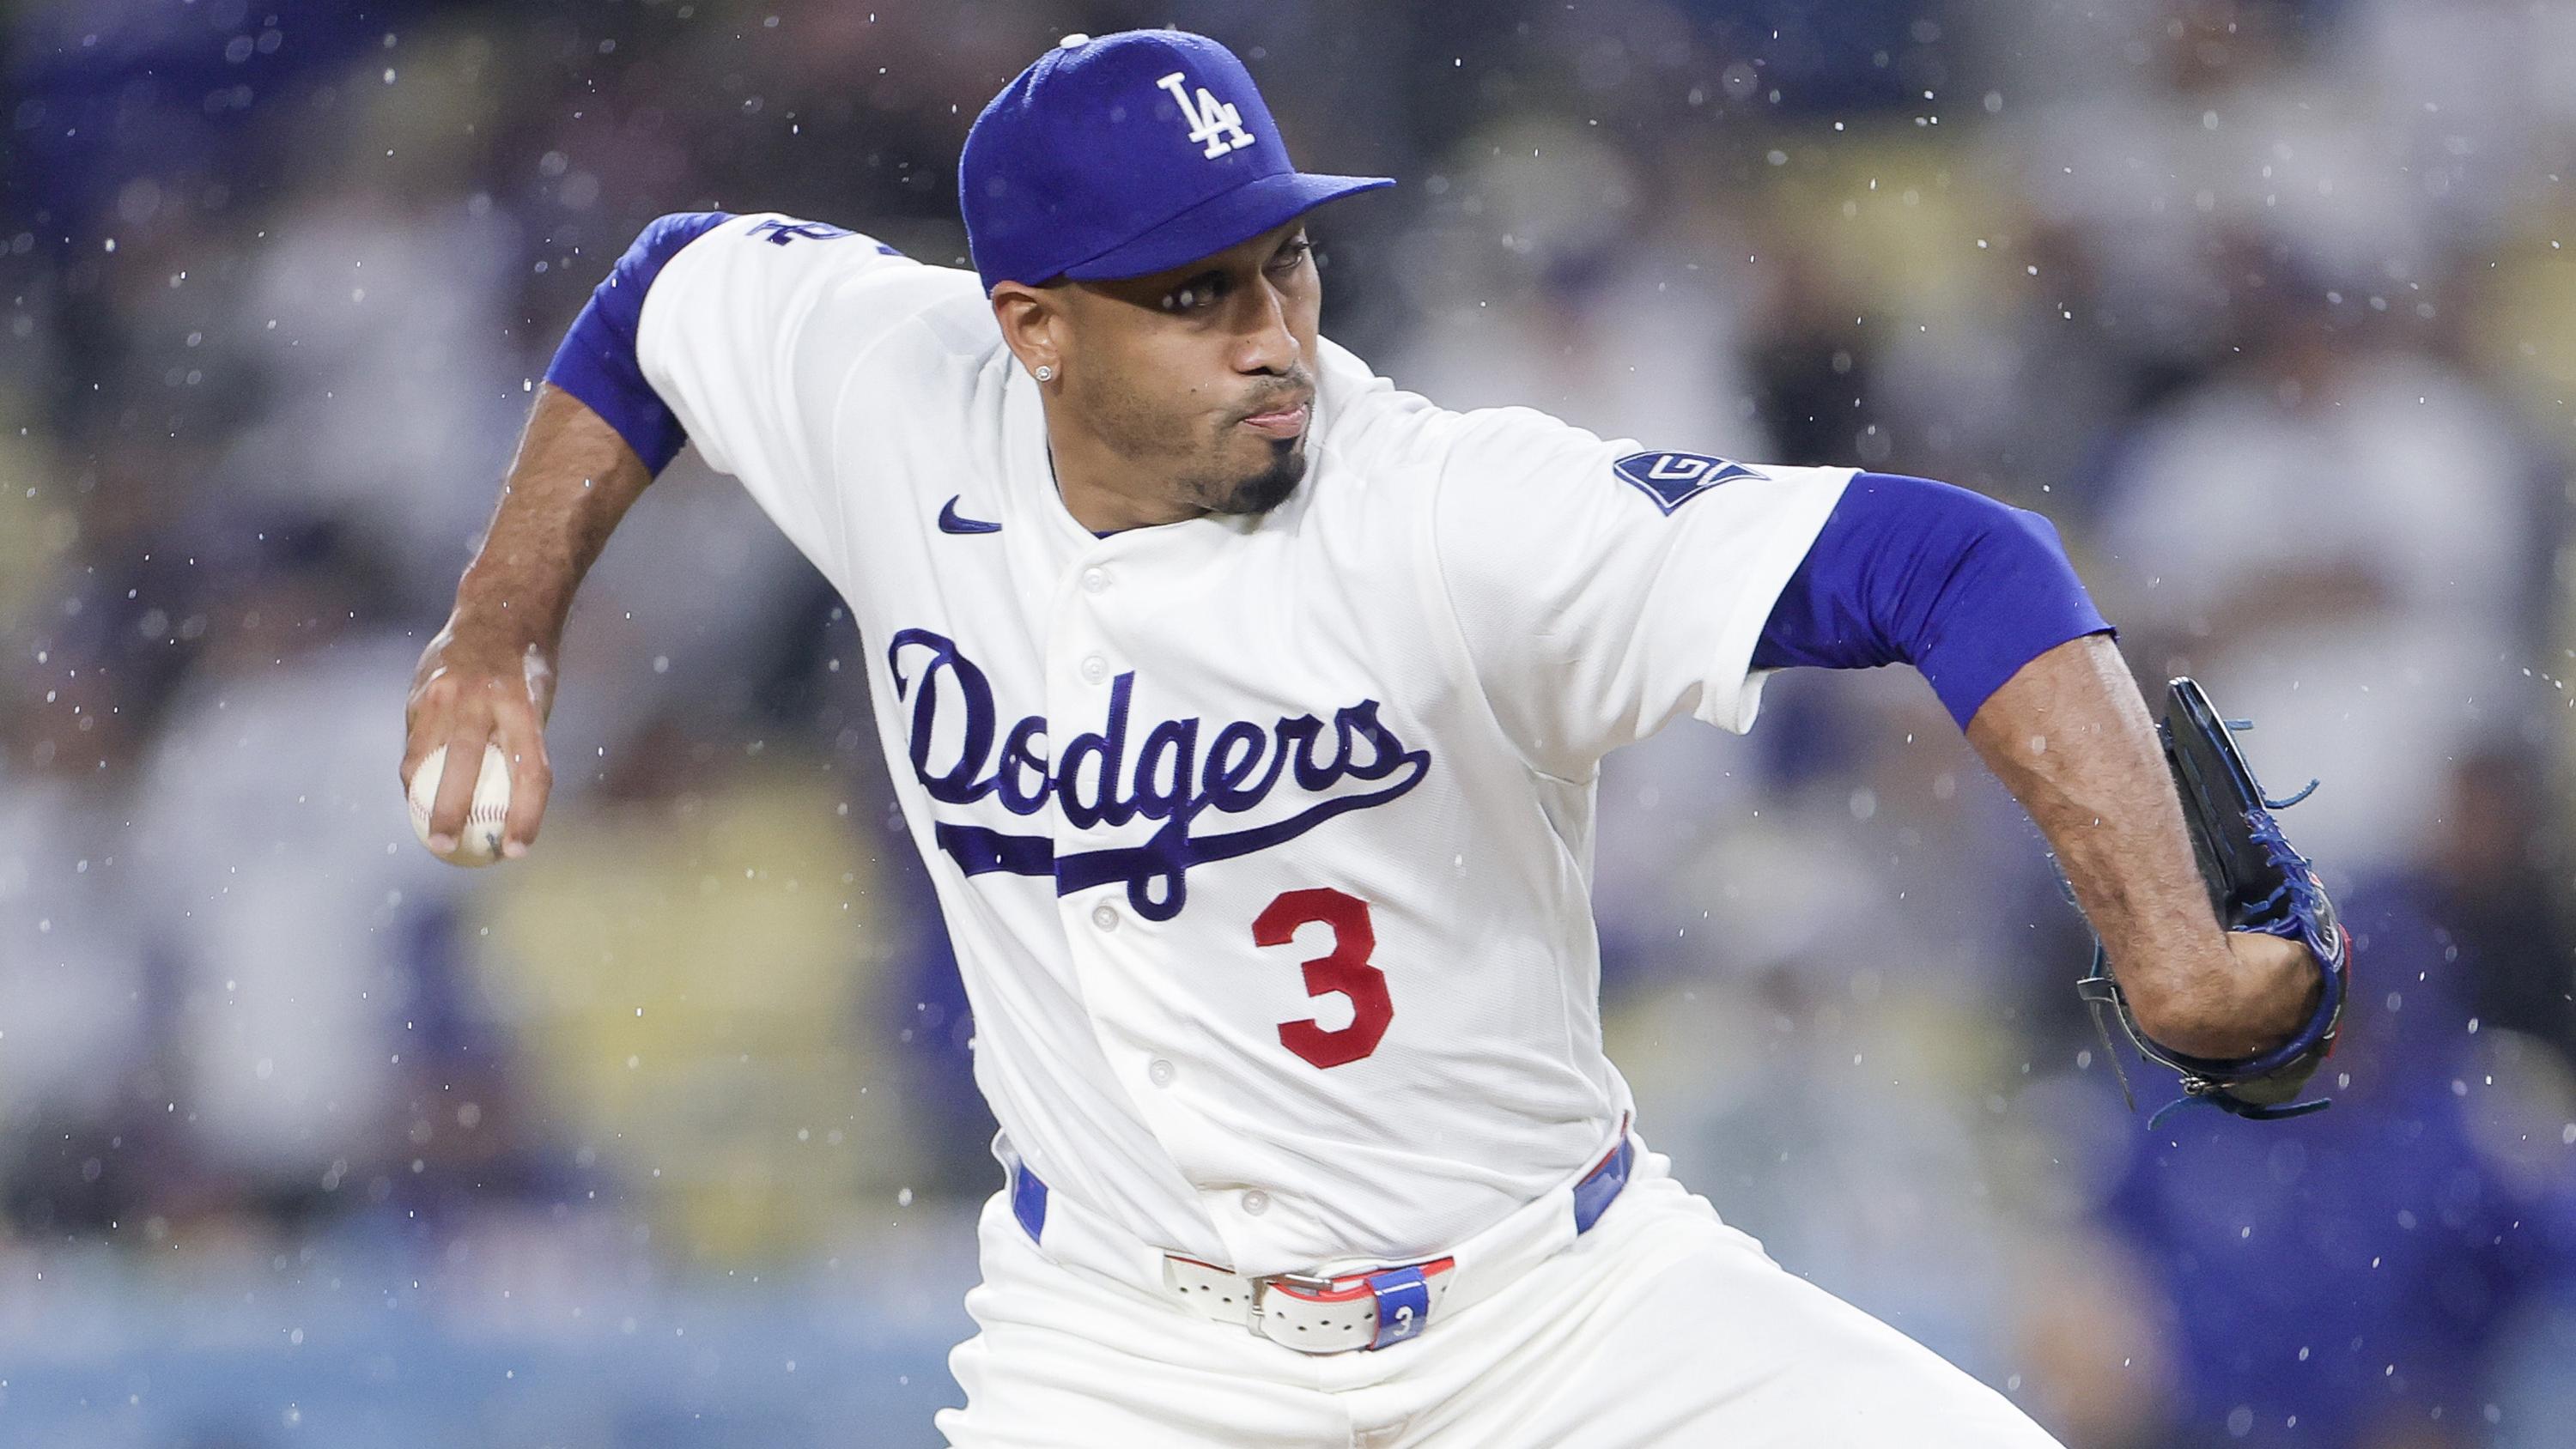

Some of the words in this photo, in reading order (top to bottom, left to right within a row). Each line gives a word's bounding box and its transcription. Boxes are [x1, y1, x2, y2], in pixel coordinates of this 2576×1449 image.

[1156, 71, 1255, 160] LA
[889, 628, 1431, 922] Dodgers
[1251, 887, 1394, 1070] 3
[1394, 1306, 1414, 1337] 3
